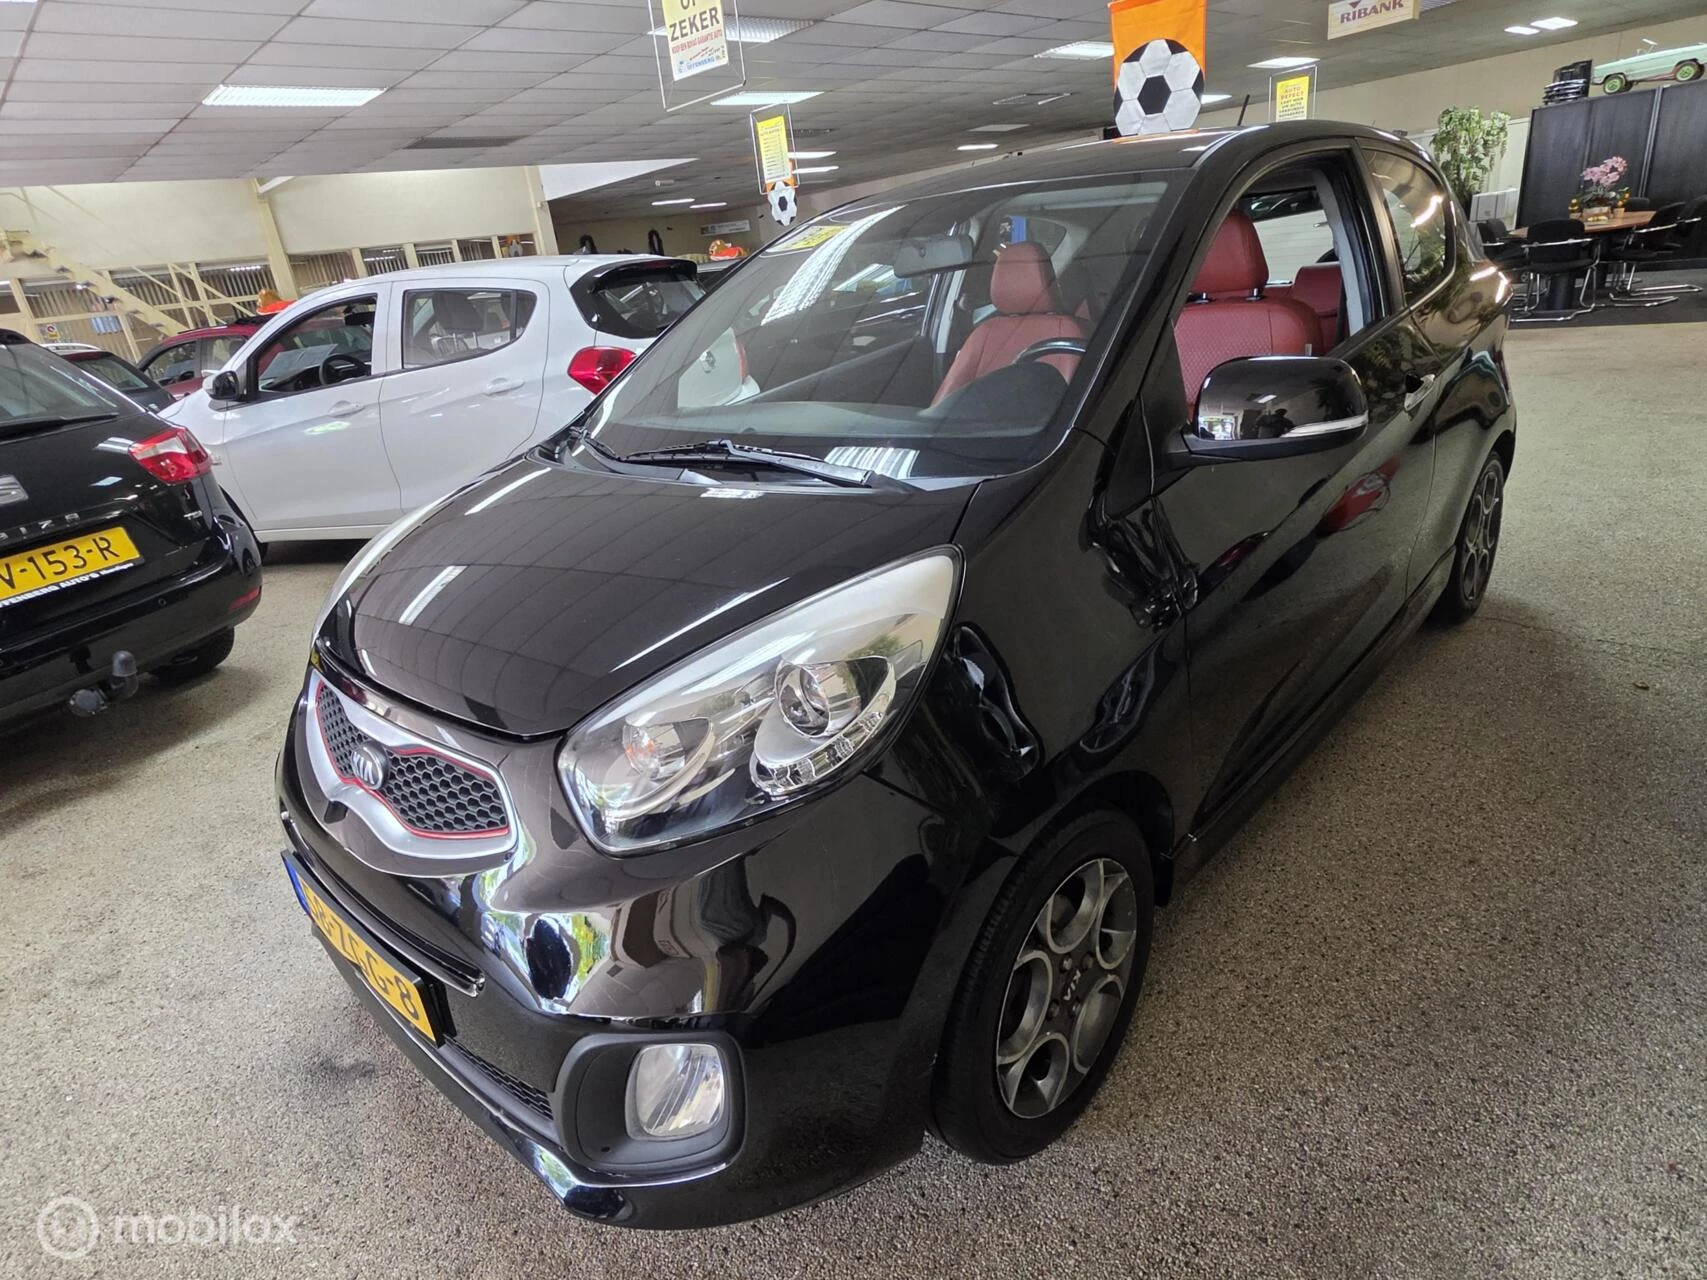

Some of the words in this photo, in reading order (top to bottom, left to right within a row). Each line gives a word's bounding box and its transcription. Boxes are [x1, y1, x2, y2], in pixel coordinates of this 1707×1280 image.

[680, 0, 696, 10] O
[1340, 0, 1404, 23] RIBANK
[669, 6, 720, 42] ZEKER
[59, 572, 99, 588] AUTO'S
[352, 751, 376, 785] KIA
